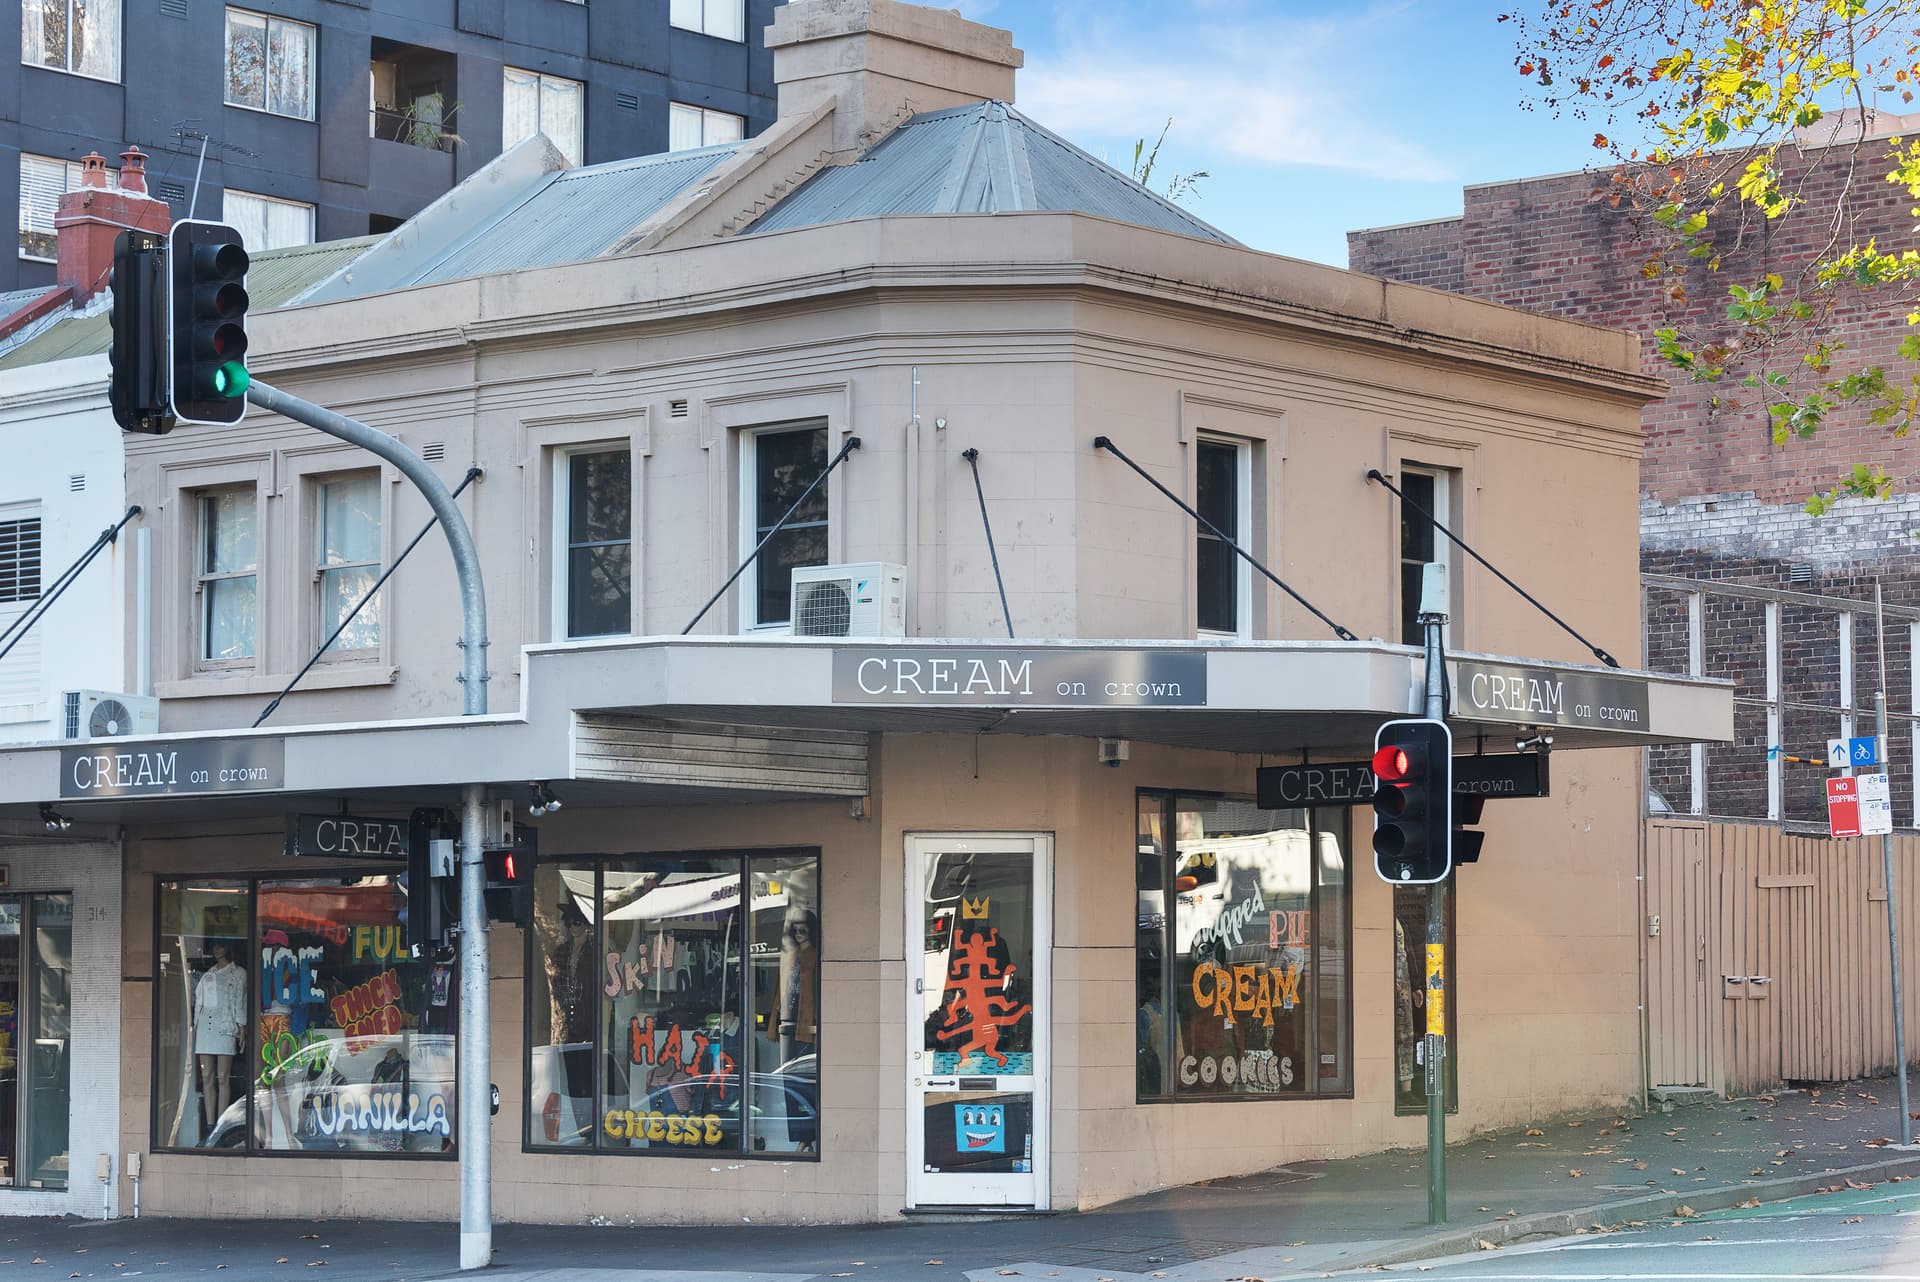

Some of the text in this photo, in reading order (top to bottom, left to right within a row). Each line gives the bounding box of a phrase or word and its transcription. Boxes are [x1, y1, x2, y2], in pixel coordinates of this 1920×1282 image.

[857, 657, 1183, 697] CREAM on crown
[1470, 672, 1639, 722] CREAM on crown
[74, 751, 268, 790] CREAM on crown
[1279, 766, 1375, 801] CREA
[1835, 782, 1848, 791] NO
[1828, 794, 1857, 803] STOPPING
[316, 819, 408, 856] CREA
[262, 947, 326, 1005] ICE
[1193, 963, 1300, 1026] CREAM
[631, 1016, 735, 1101] HAIR
[1180, 1055, 1294, 1086] COOKIES
[312, 1092, 451, 1137] VANILLA
[605, 1110, 722, 1145] CHEESE
